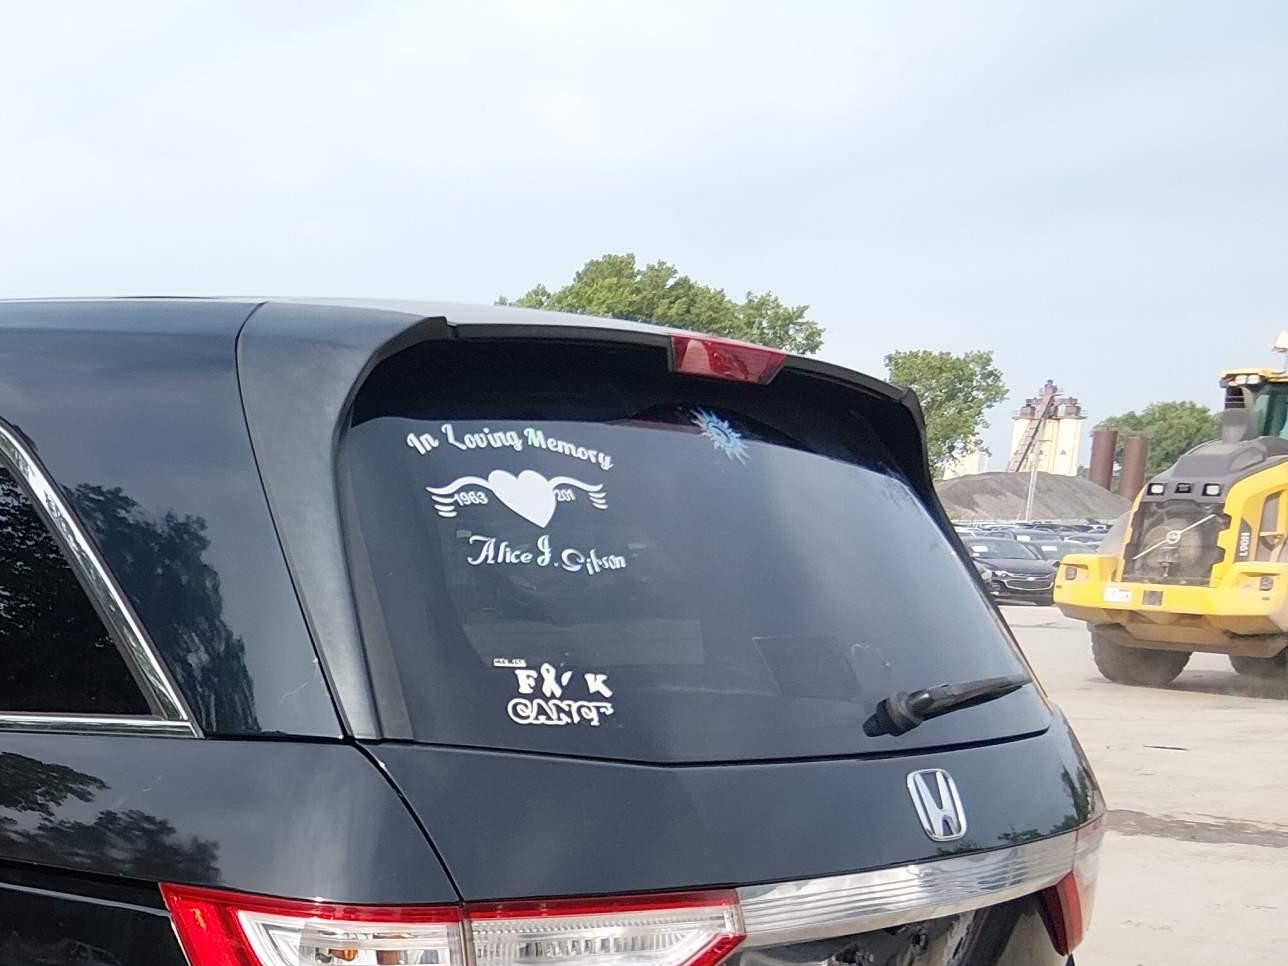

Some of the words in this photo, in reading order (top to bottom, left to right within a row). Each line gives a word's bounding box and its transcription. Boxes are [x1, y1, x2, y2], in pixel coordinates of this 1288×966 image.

[407, 433, 439, 455] In
[441, 424, 522, 451] Loving
[524, 428, 613, 470] Memory
[467, 535, 533, 565] Alice
